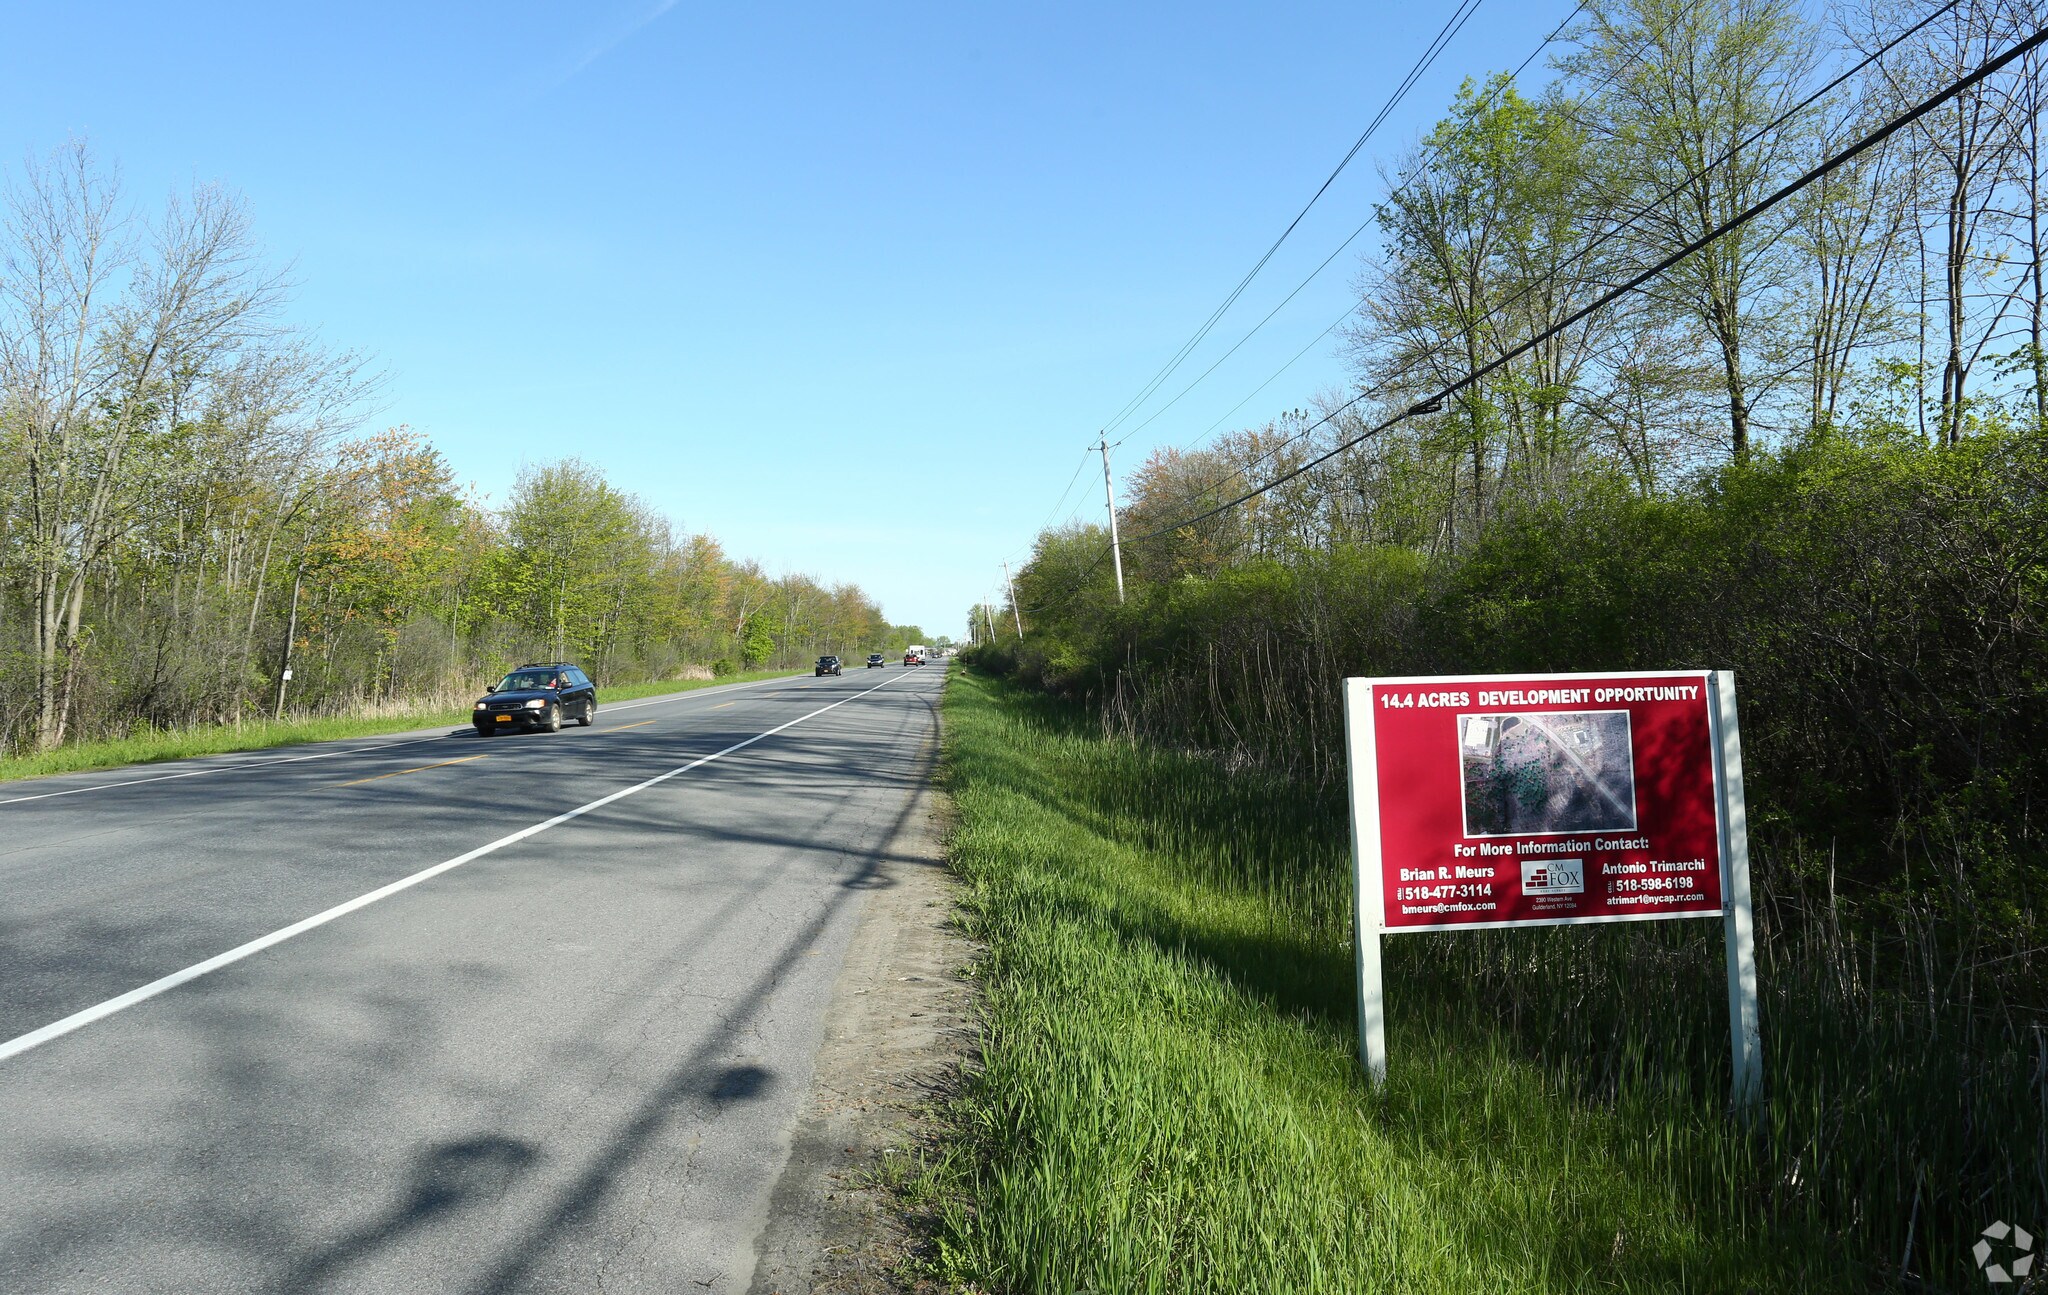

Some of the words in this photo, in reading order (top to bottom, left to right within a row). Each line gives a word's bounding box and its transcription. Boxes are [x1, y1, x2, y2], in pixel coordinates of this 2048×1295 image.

[1381, 693, 1414, 709] 14.4
[1418, 691, 1470, 708] ACRES
[1478, 688, 1590, 706] DEVELOPMENT
[1594, 685, 1699, 703] OPPORTUNITY
[1454, 843, 1477, 857] For
[1480, 843, 1513, 857] More
[1516, 840, 1591, 855] Information
[1595, 837, 1649, 851] Contact:
[1400, 867, 1435, 881] Brian
[1438, 866, 1452, 880] R.
[1455, 865, 1495, 879] Meurs
[1547, 863, 1564, 872] CM
[1602, 861, 1647, 875] Antonio
[1649, 858, 1705, 873] Trimarchi
[1550, 871, 1580, 886] FOX
[1616, 876, 1694, 892] 518-598-6198
[1405, 883, 1492, 900] 518-477-3114
[1606, 893, 1705, 905] atrimar1@nycap.rr.com
[1402, 901, 1497, 914] bmeurs@cmfox.com
